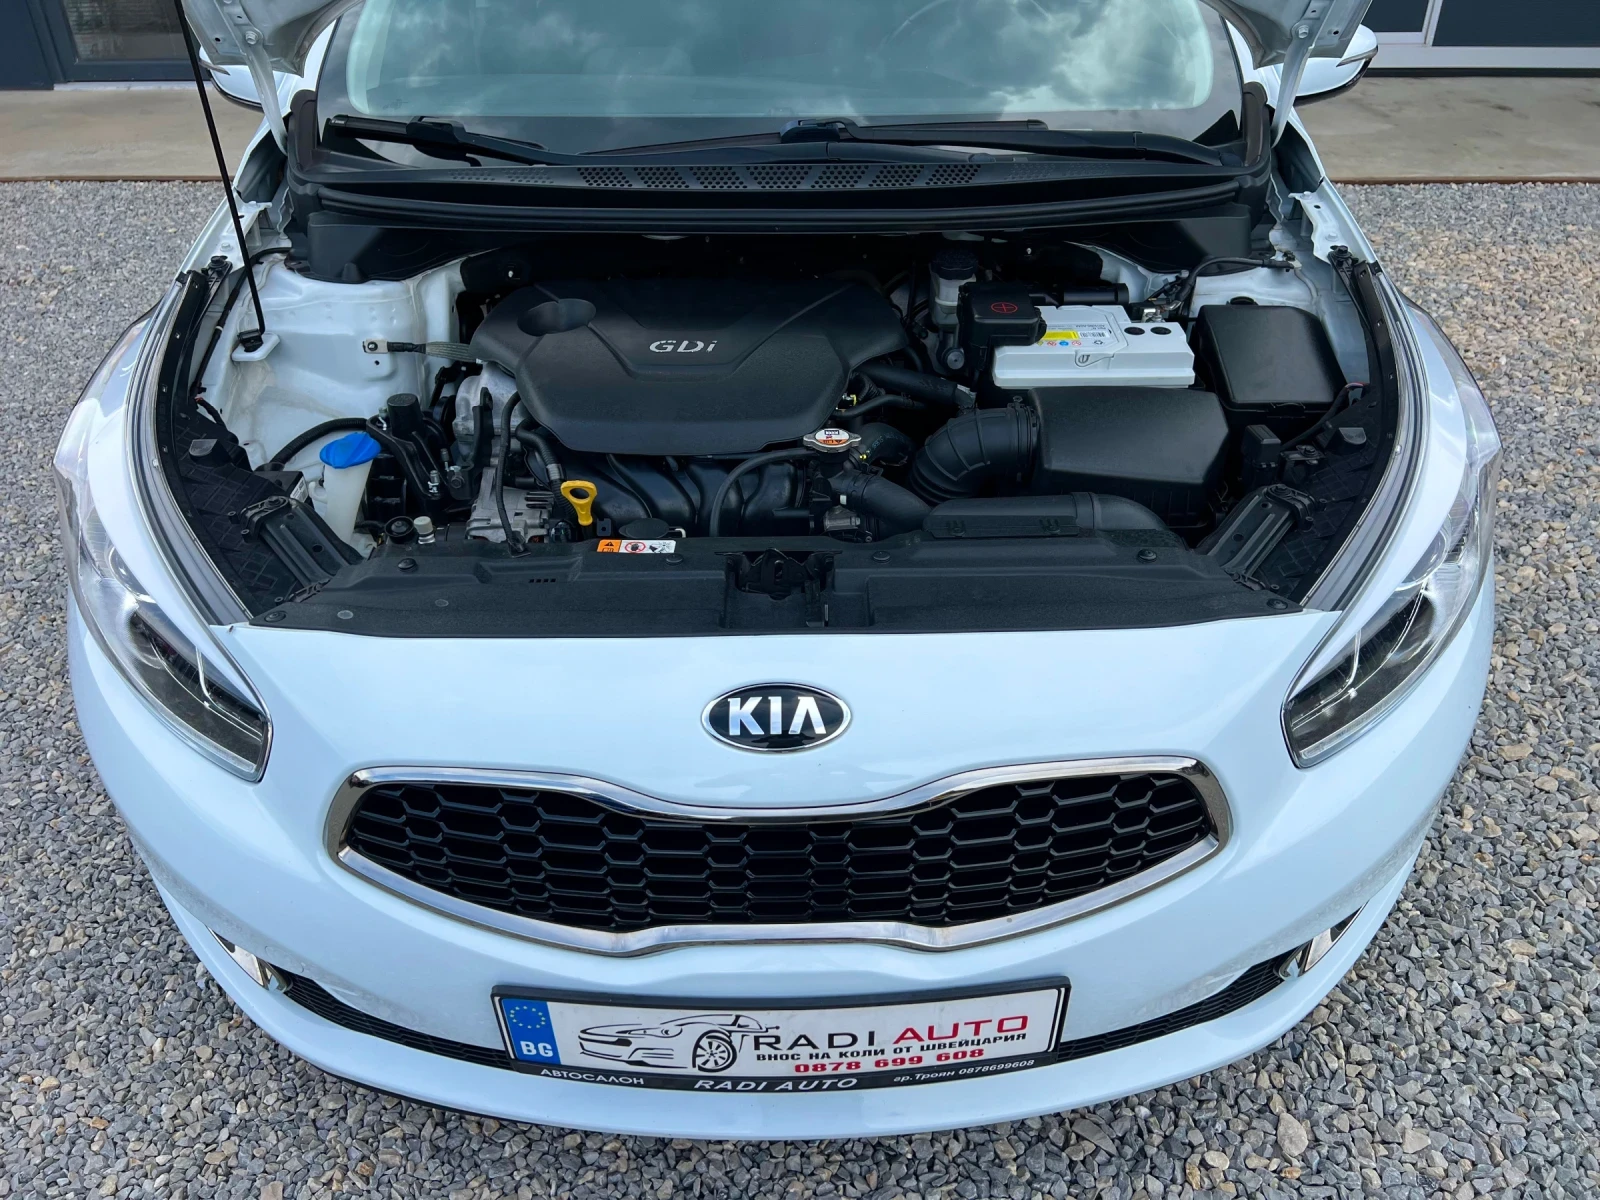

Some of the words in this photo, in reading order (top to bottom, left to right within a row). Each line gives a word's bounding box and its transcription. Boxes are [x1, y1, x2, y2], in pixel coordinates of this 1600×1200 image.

[649, 340, 718, 352] GDi
[728, 696, 827, 736] KIA
[753, 1031, 876, 1051] RADI
[892, 1015, 1029, 1045] AUTO
[520, 1040, 554, 1057] BG
[756, 1053, 801, 1061] ВНОС
[808, 1052, 831, 1060] НА
[839, 1048, 885, 1059] КОЛИ
[893, 1045, 913, 1055] ОТ
[920, 1033, 1027, 1052] ШВЕЙЦАРИЯ
[795, 1061, 862, 1073] 0878
[874, 1055, 923, 1068] 699
[936, 1048, 985, 1062] 608
[958, 1060, 1035, 1075] 0878699608
[540, 1068, 645, 1085] АВТОСАЛОН
[694, 1080, 767, 1091] RADI
[775, 1078, 858, 1091] AUTO
